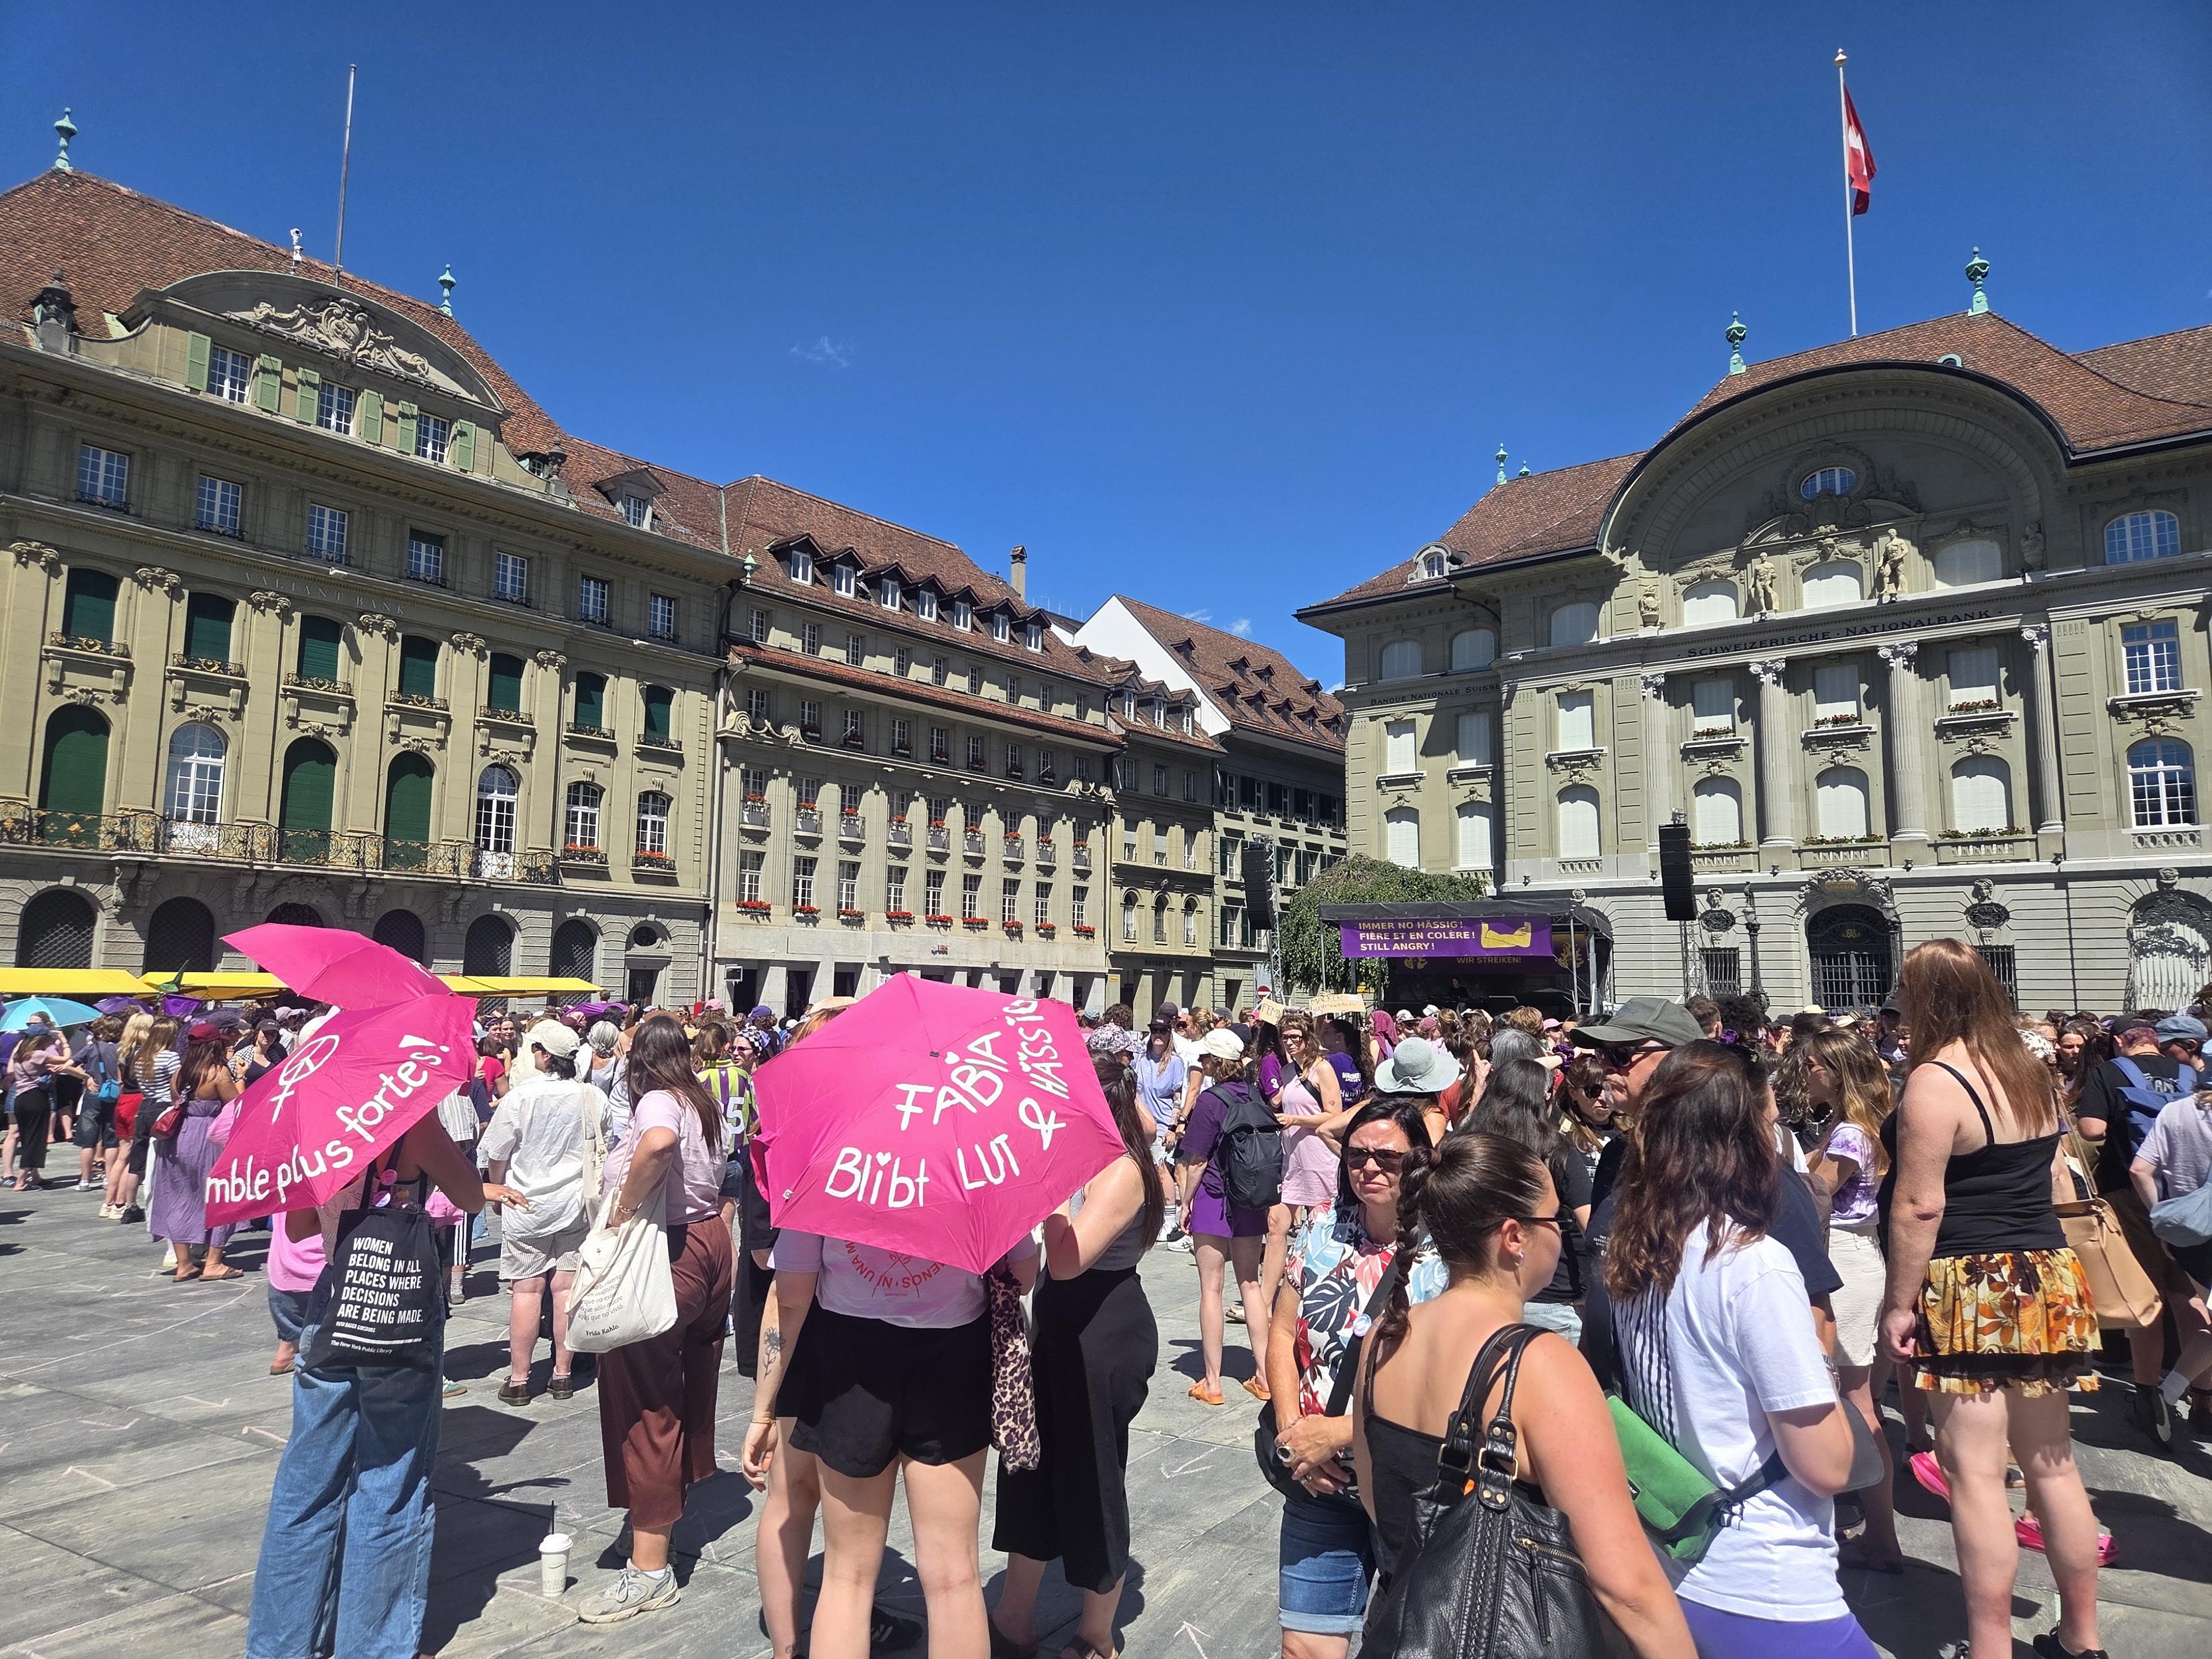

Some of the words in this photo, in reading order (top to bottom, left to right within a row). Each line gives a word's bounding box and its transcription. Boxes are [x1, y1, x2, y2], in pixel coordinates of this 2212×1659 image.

[245, 572, 343, 601] VALIANT
[357, 597, 404, 615] BANK
[1687, 631, 1830, 657] SCHWEIZERISCHE
[1845, 609, 1992, 637] NATIONALBANK
[1370, 695, 1406, 706] BANQUE
[1411, 688, 1460, 700] NATIONALE
[1466, 683, 1501, 693] SUISSE
[1359, 931, 1390, 940] FIÈRE
[277, 1139, 354, 1204] plus
[335, 1034, 451, 1143] fortes!
[957, 1133, 1021, 1190] LUT
[1018, 1097, 1066, 1151] &
[353, 1237, 393, 1255] WOMEN
[348, 1253, 391, 1272] BELONG
[393, 1259, 405, 1273] IN
[406, 1259, 422, 1273] ALL
[345, 1269, 387, 1288] PLACES
[389, 1276, 422, 1290] WHERE
[901, 1261, 946, 1288] ENOS
[341, 1286, 400, 1307] DECISIONS
[337, 1303, 361, 1319] ARE
[361, 1307, 395, 1324] BEING
[397, 1309, 424, 1324] MADE.
